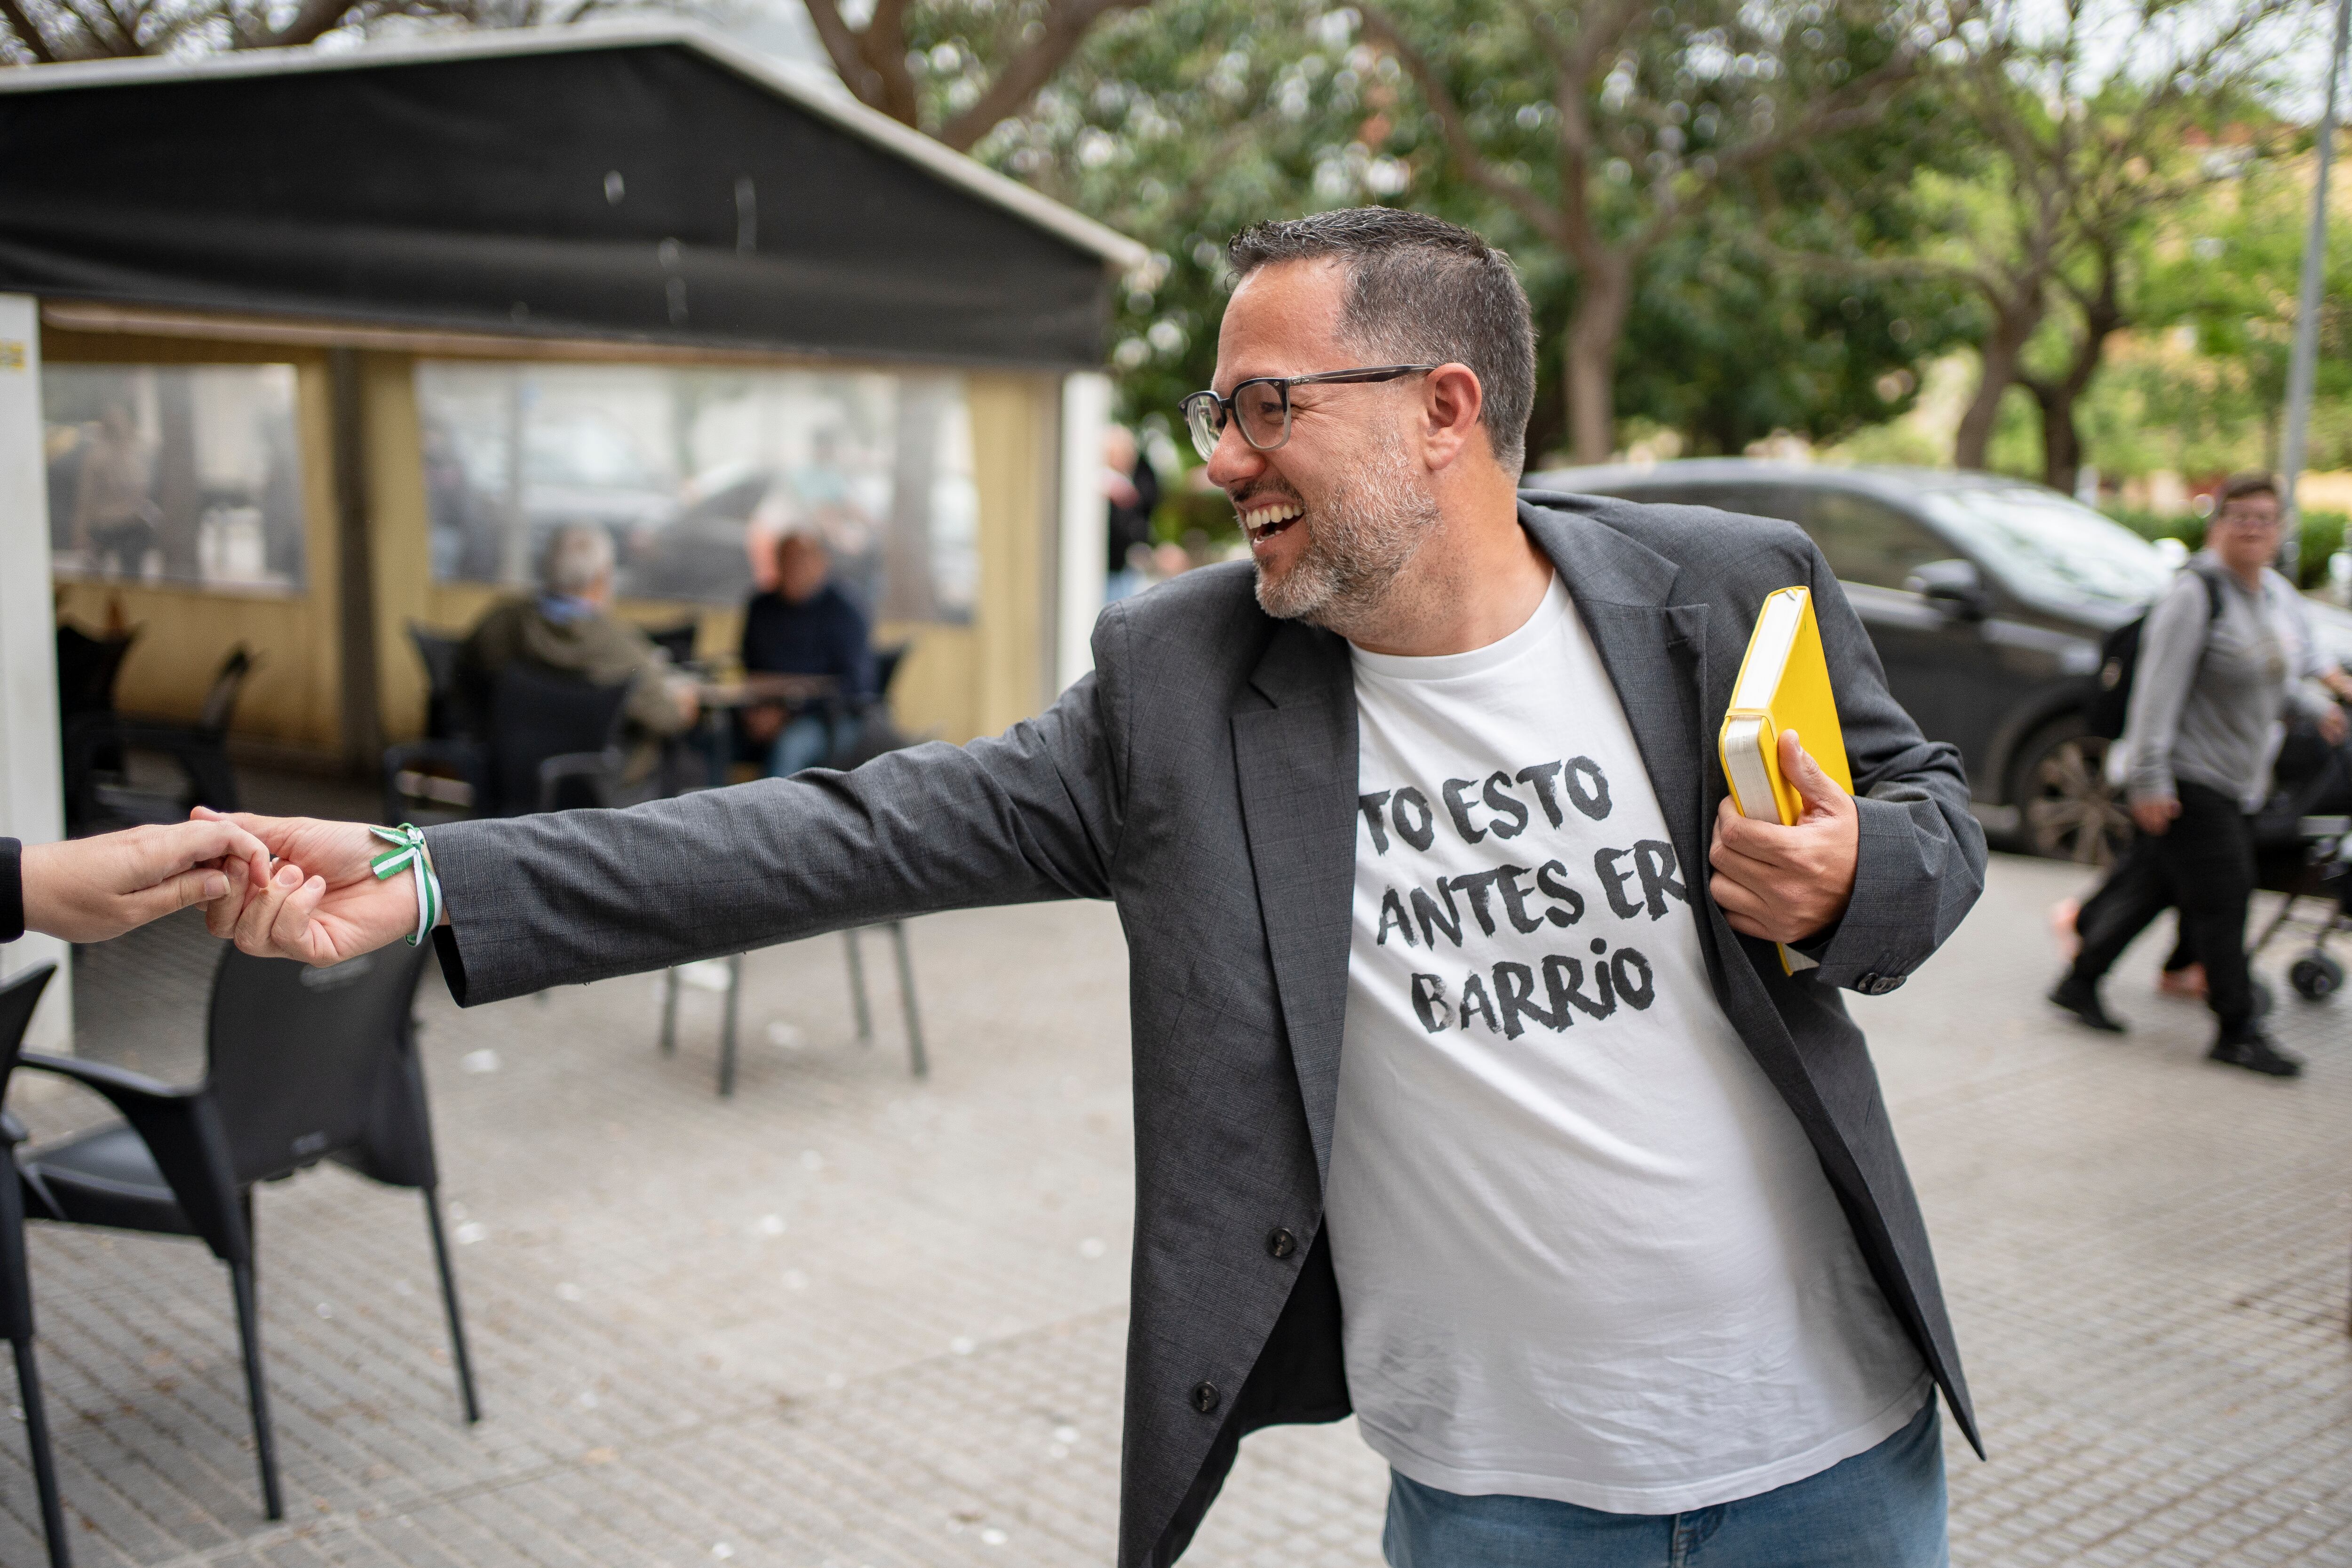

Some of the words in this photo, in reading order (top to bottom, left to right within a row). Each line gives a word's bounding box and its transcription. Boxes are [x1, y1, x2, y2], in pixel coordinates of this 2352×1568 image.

[1359, 786, 1435, 856] TO
[1443, 756, 1613, 845] ESTO
[1376, 860, 1585, 951] ANTES
[1594, 839, 1691, 922] ER
